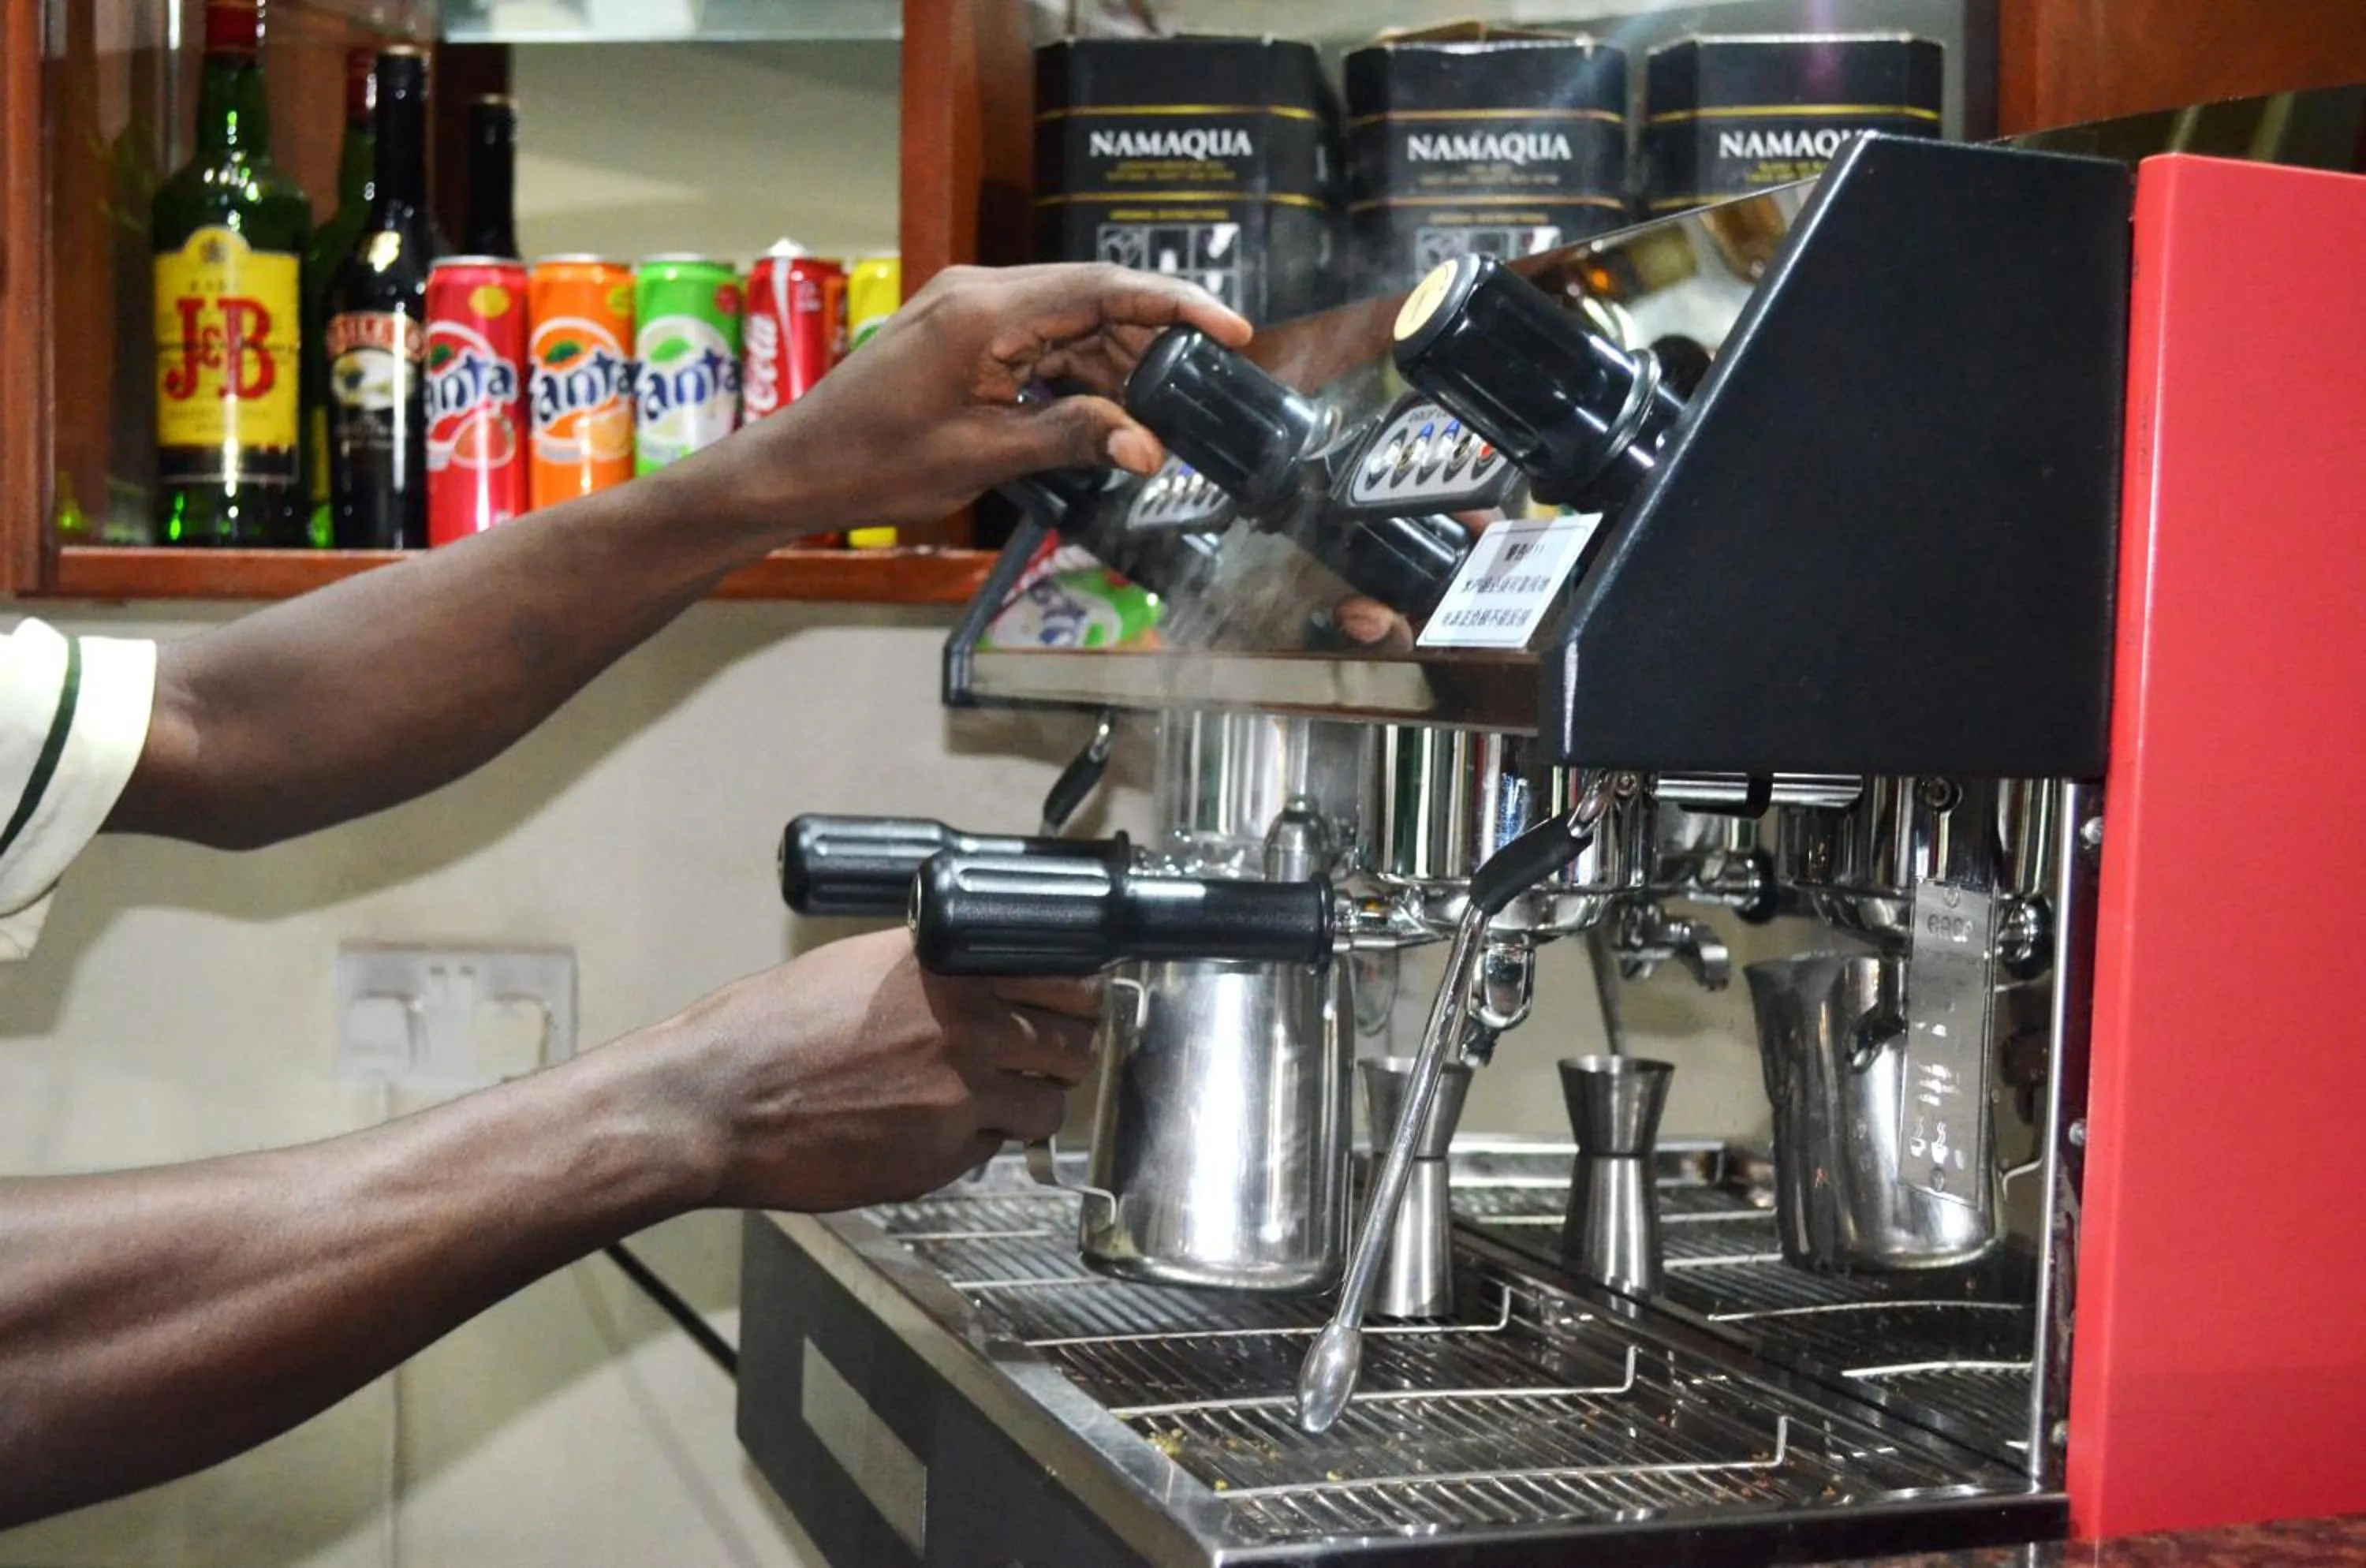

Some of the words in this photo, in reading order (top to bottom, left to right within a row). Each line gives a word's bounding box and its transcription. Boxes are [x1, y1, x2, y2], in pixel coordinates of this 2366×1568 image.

[1089, 129, 1253, 161] NAMAQUA
[1407, 131, 1573, 165] NAMAQUA
[1719, 129, 1863, 159] NAMAQ
[425, 354, 513, 424] anta
[529, 350, 633, 423] anta
